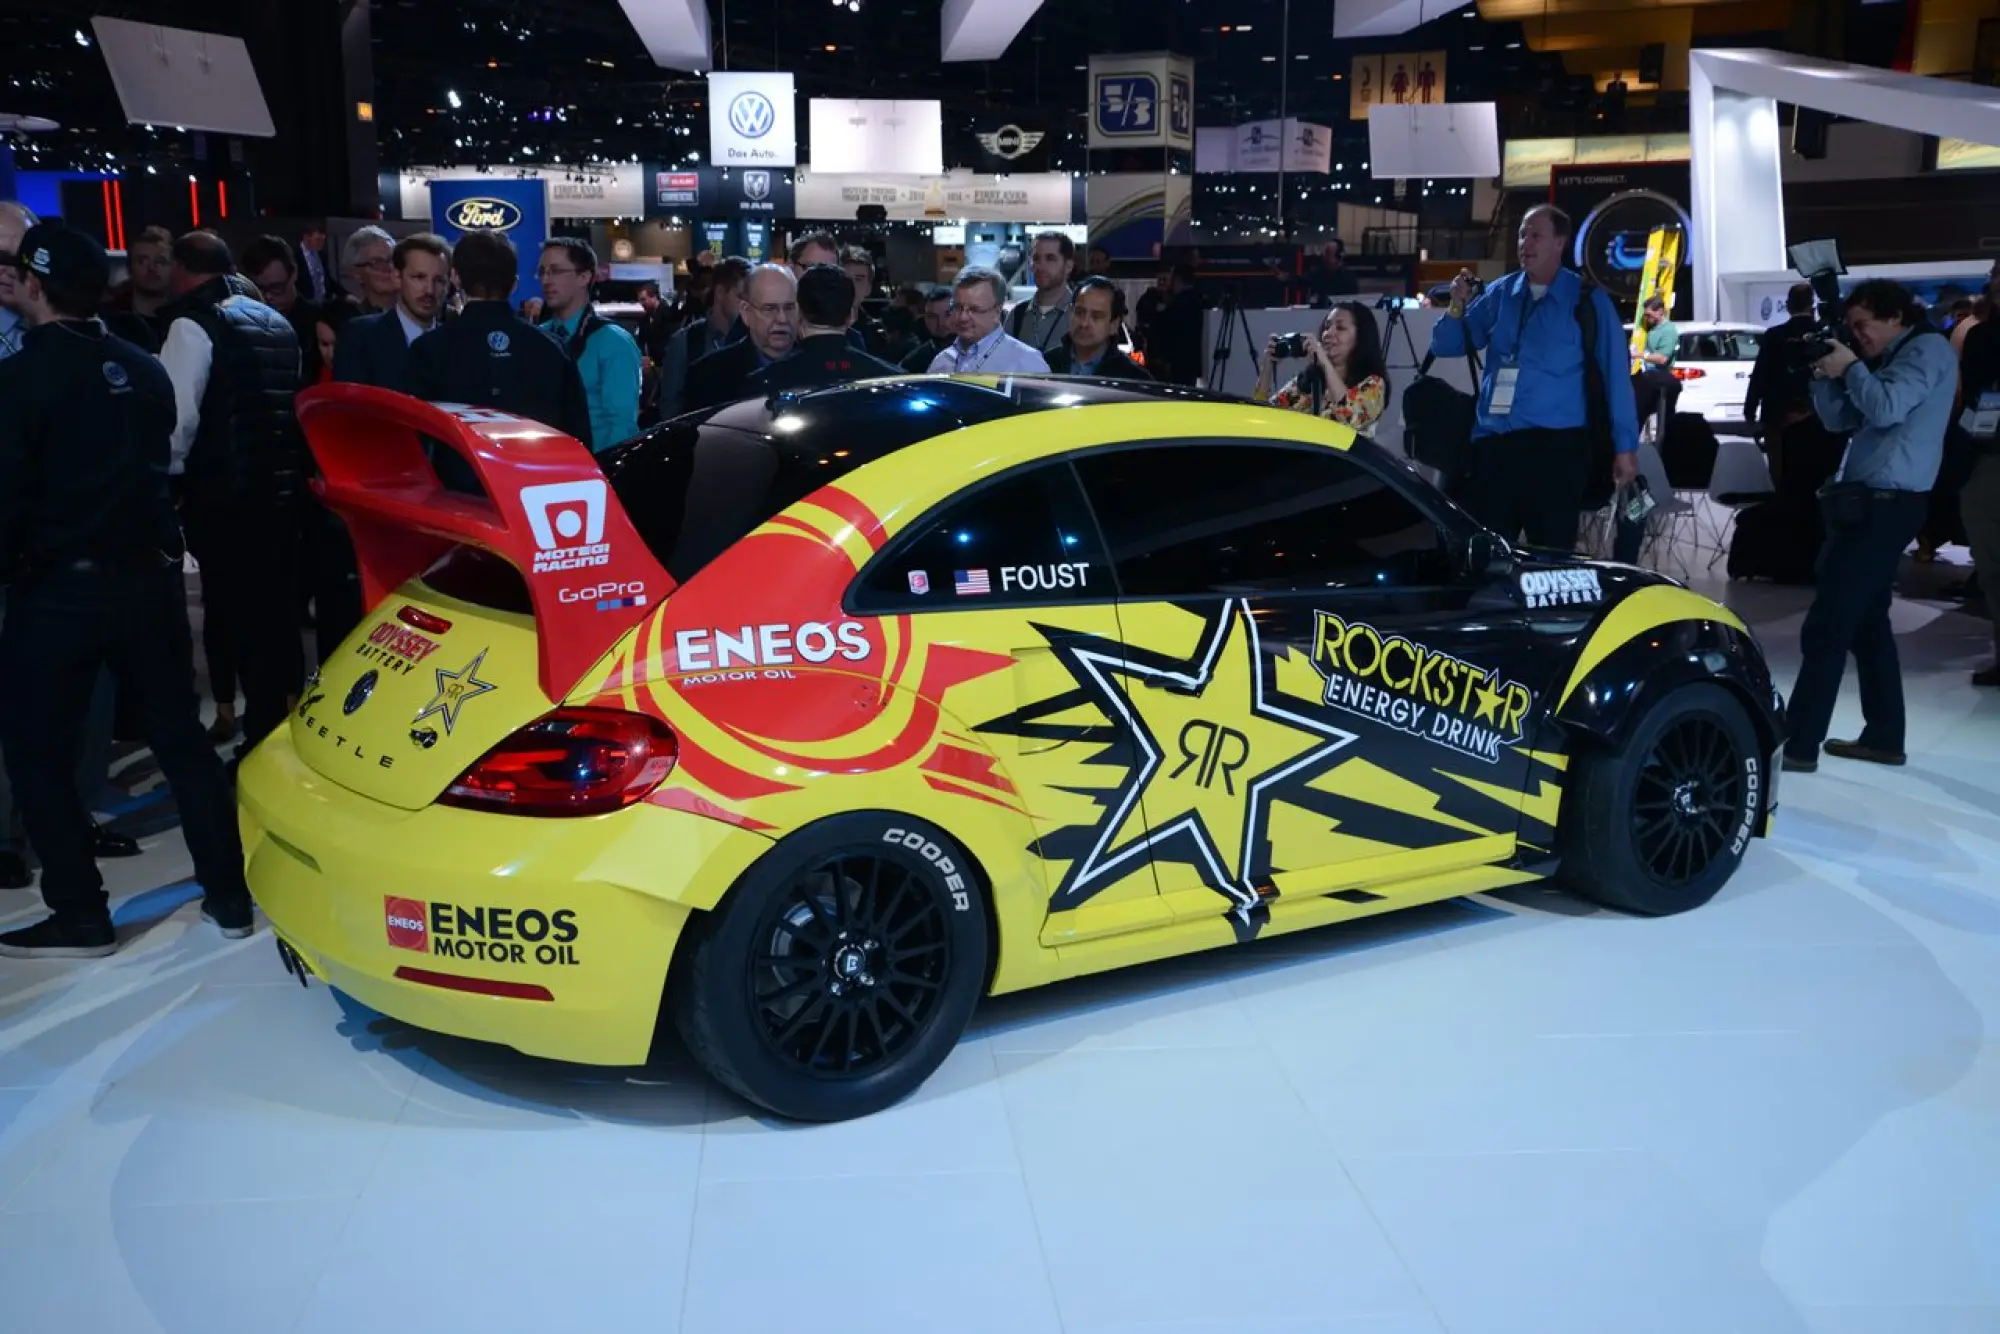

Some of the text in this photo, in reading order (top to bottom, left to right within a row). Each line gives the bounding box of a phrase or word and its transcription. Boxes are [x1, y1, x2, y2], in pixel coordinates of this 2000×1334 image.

[459, 202, 505, 226] Ford
[532, 555, 609, 574] RACING
[534, 543, 610, 561] MOTEGI
[1000, 562, 1089, 591] FOUST
[1521, 569, 1600, 595] ODYSSEY
[558, 581, 644, 603] GoPro
[1526, 588, 1602, 609] BATTERY
[355, 643, 415, 676] BATTERY
[674, 621, 871, 672] ENEOS
[683, 669, 797, 686] MOTOR OIL
[1328, 673, 1502, 758] ENERGY DRINK
[1730, 757, 1760, 856] COOPER
[882, 828, 970, 912] COOPER
[387, 914, 425, 932] ENEOS
[431, 902, 579, 943] ENEOS
[433, 937, 580, 965] MOTOR OIL
